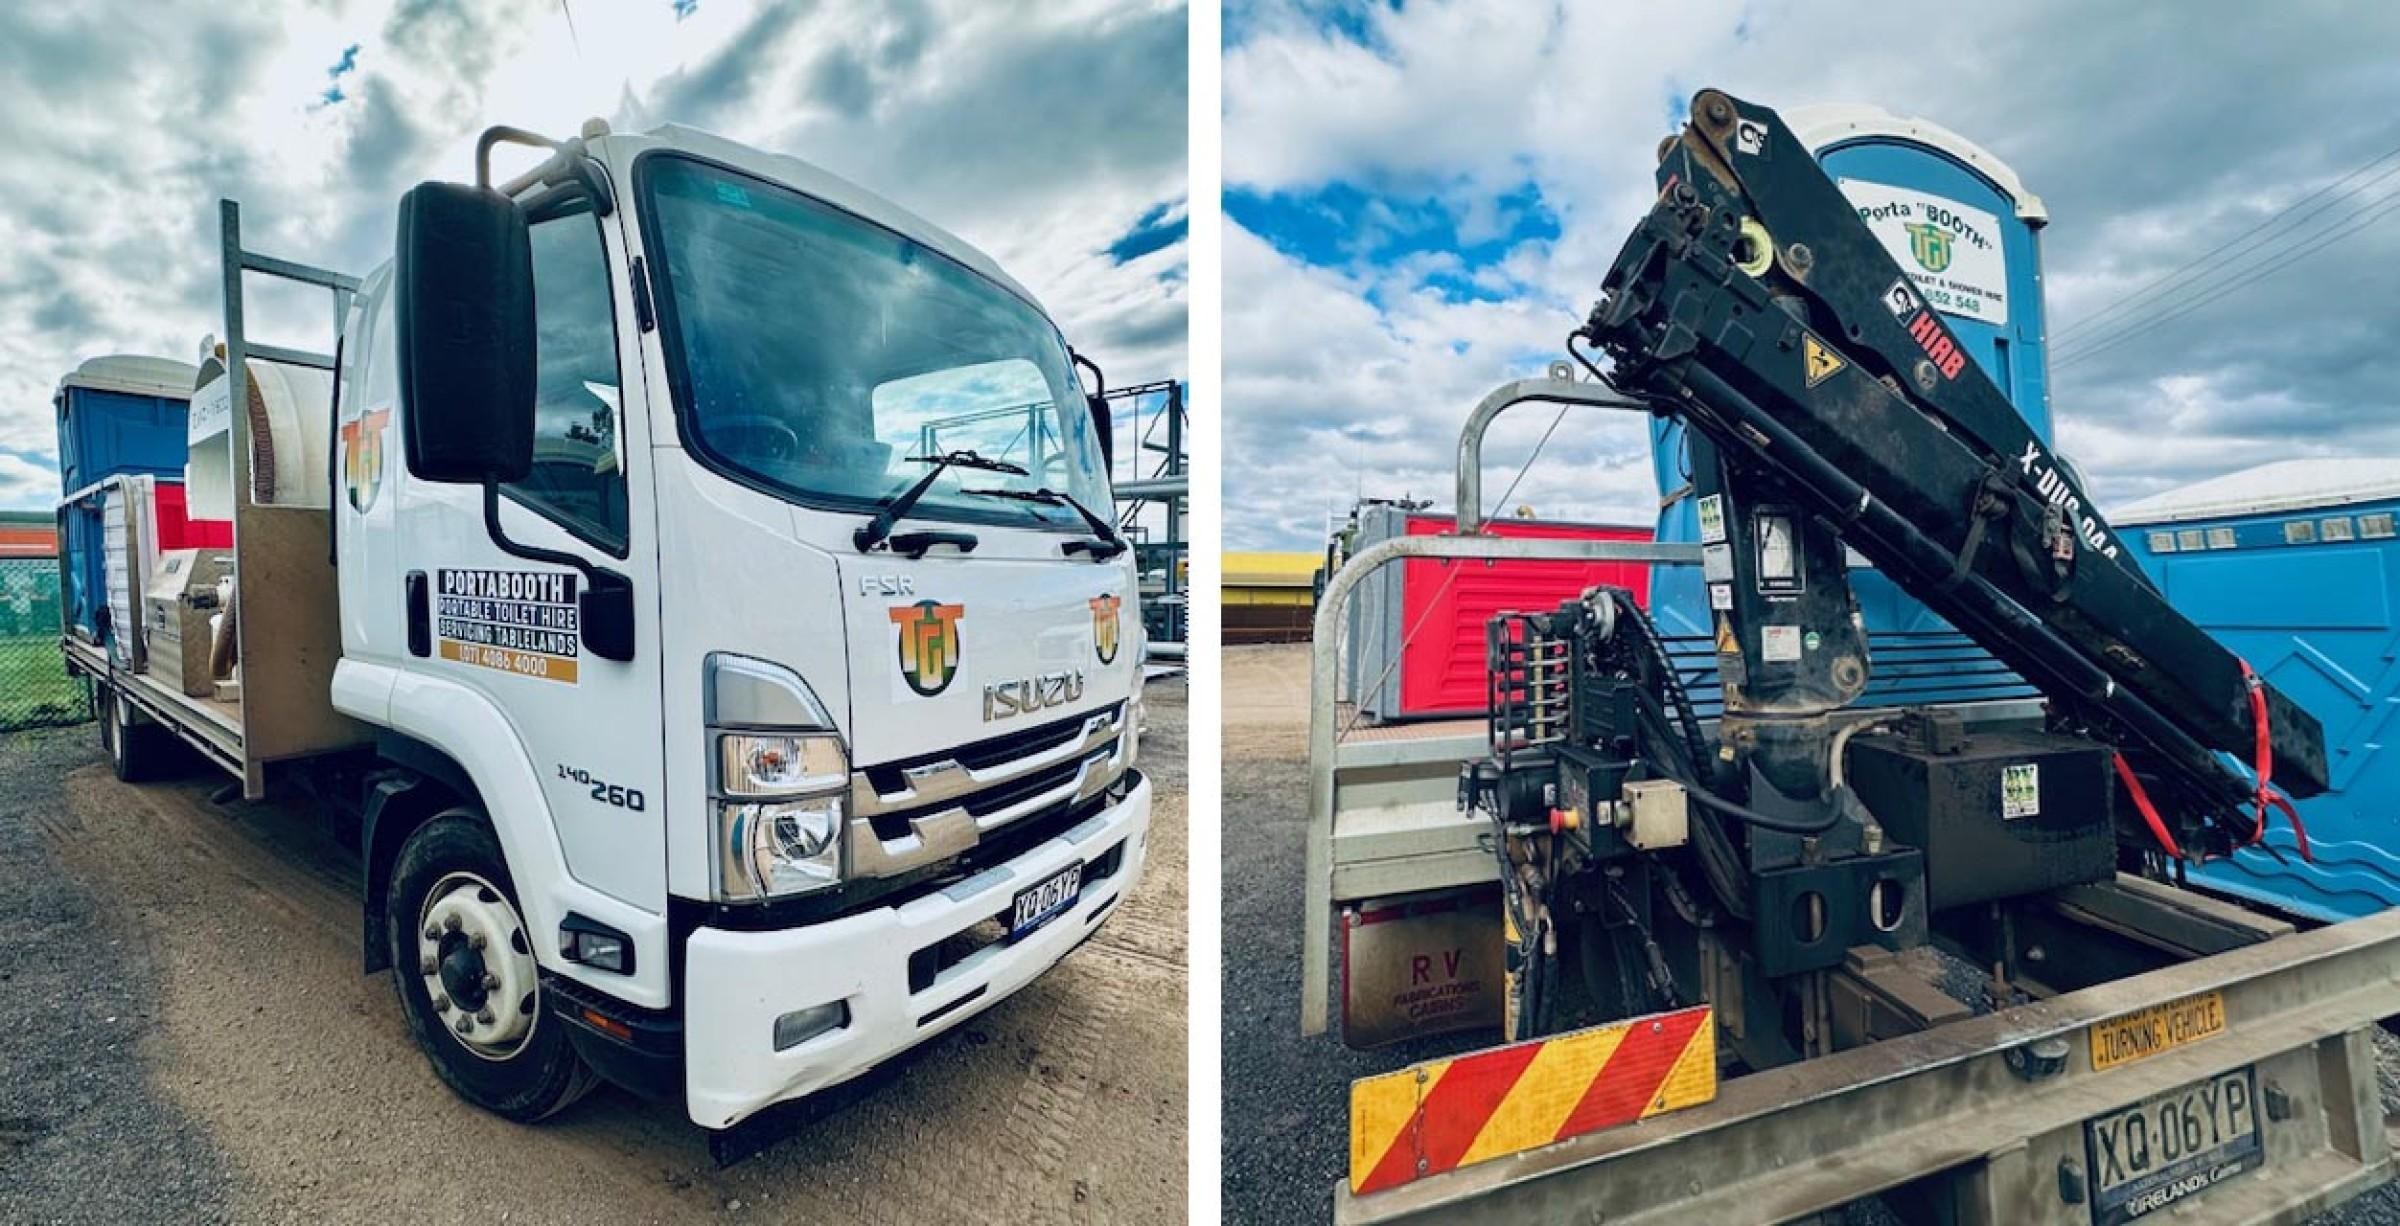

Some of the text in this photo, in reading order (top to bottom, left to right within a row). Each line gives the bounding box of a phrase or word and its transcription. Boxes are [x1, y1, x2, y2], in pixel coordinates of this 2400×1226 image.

[1860, 201, 1911, 223] Porta
[1909, 310, 1965, 380] HIAB
[446, 570, 564, 602] PORTABOOTH
[859, 575, 915, 597] FSR
[440, 598, 576, 630] PORTABLE TOILET HIRE
[440, 619, 576, 657] SERVICING TABLELANDS
[889, 603, 964, 690] TGT
[514, 653, 547, 676] 4000
[983, 667, 1084, 723] ISUZU
[557, 764, 645, 813] 140 260
[2102, 1017, 2162, 1064] TURNING
[2165, 1001, 2218, 1044] VEHICLE
